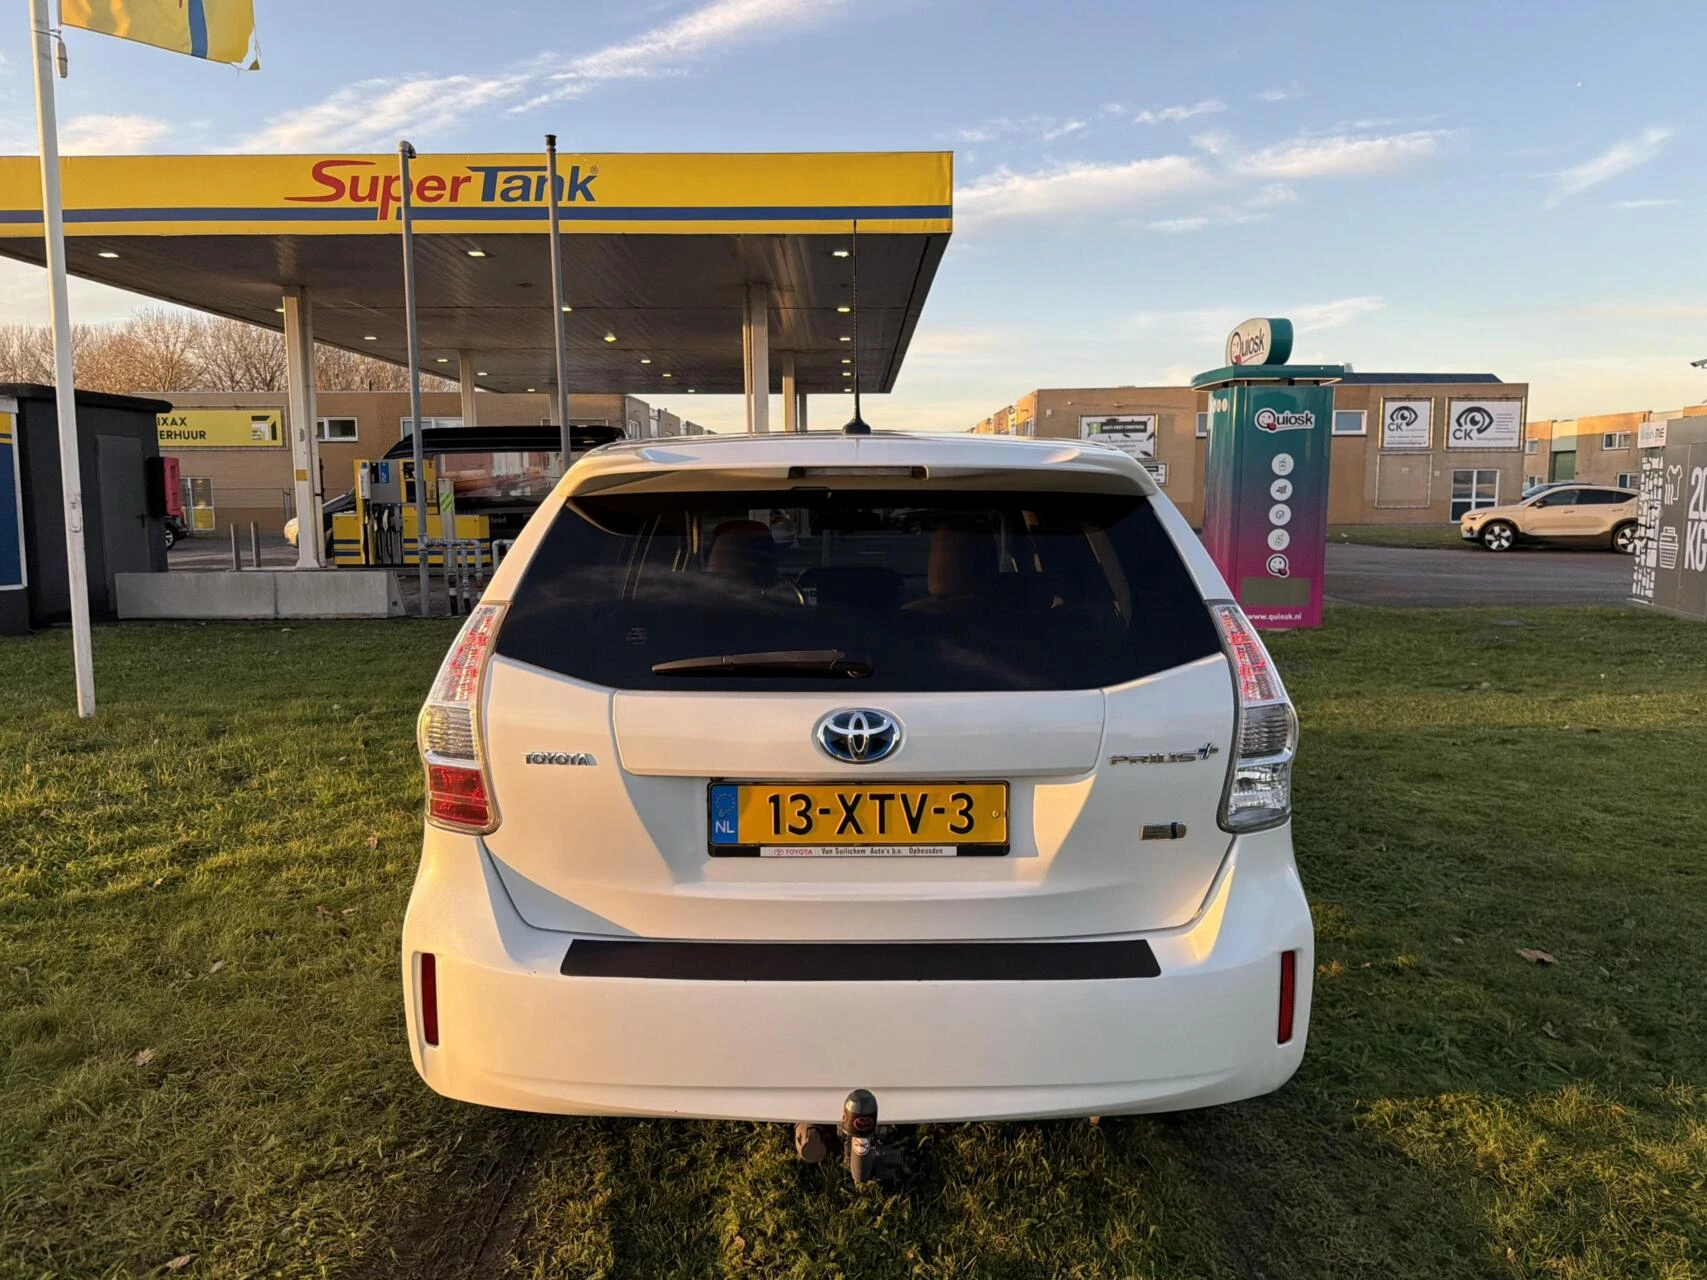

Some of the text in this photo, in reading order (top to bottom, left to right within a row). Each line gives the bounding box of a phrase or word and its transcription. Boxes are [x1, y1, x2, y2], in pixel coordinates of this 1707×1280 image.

[1230, 328, 1265, 365] Quiosk
[1256, 409, 1314, 431] Quiosk
[1387, 422, 1404, 432] CK
[1453, 428, 1474, 441] CK
[523, 752, 597, 766] TOYOTA
[768, 792, 975, 835] 13-XTV-3
[715, 820, 735, 833] NL
[822, 847, 833, 855] Van
